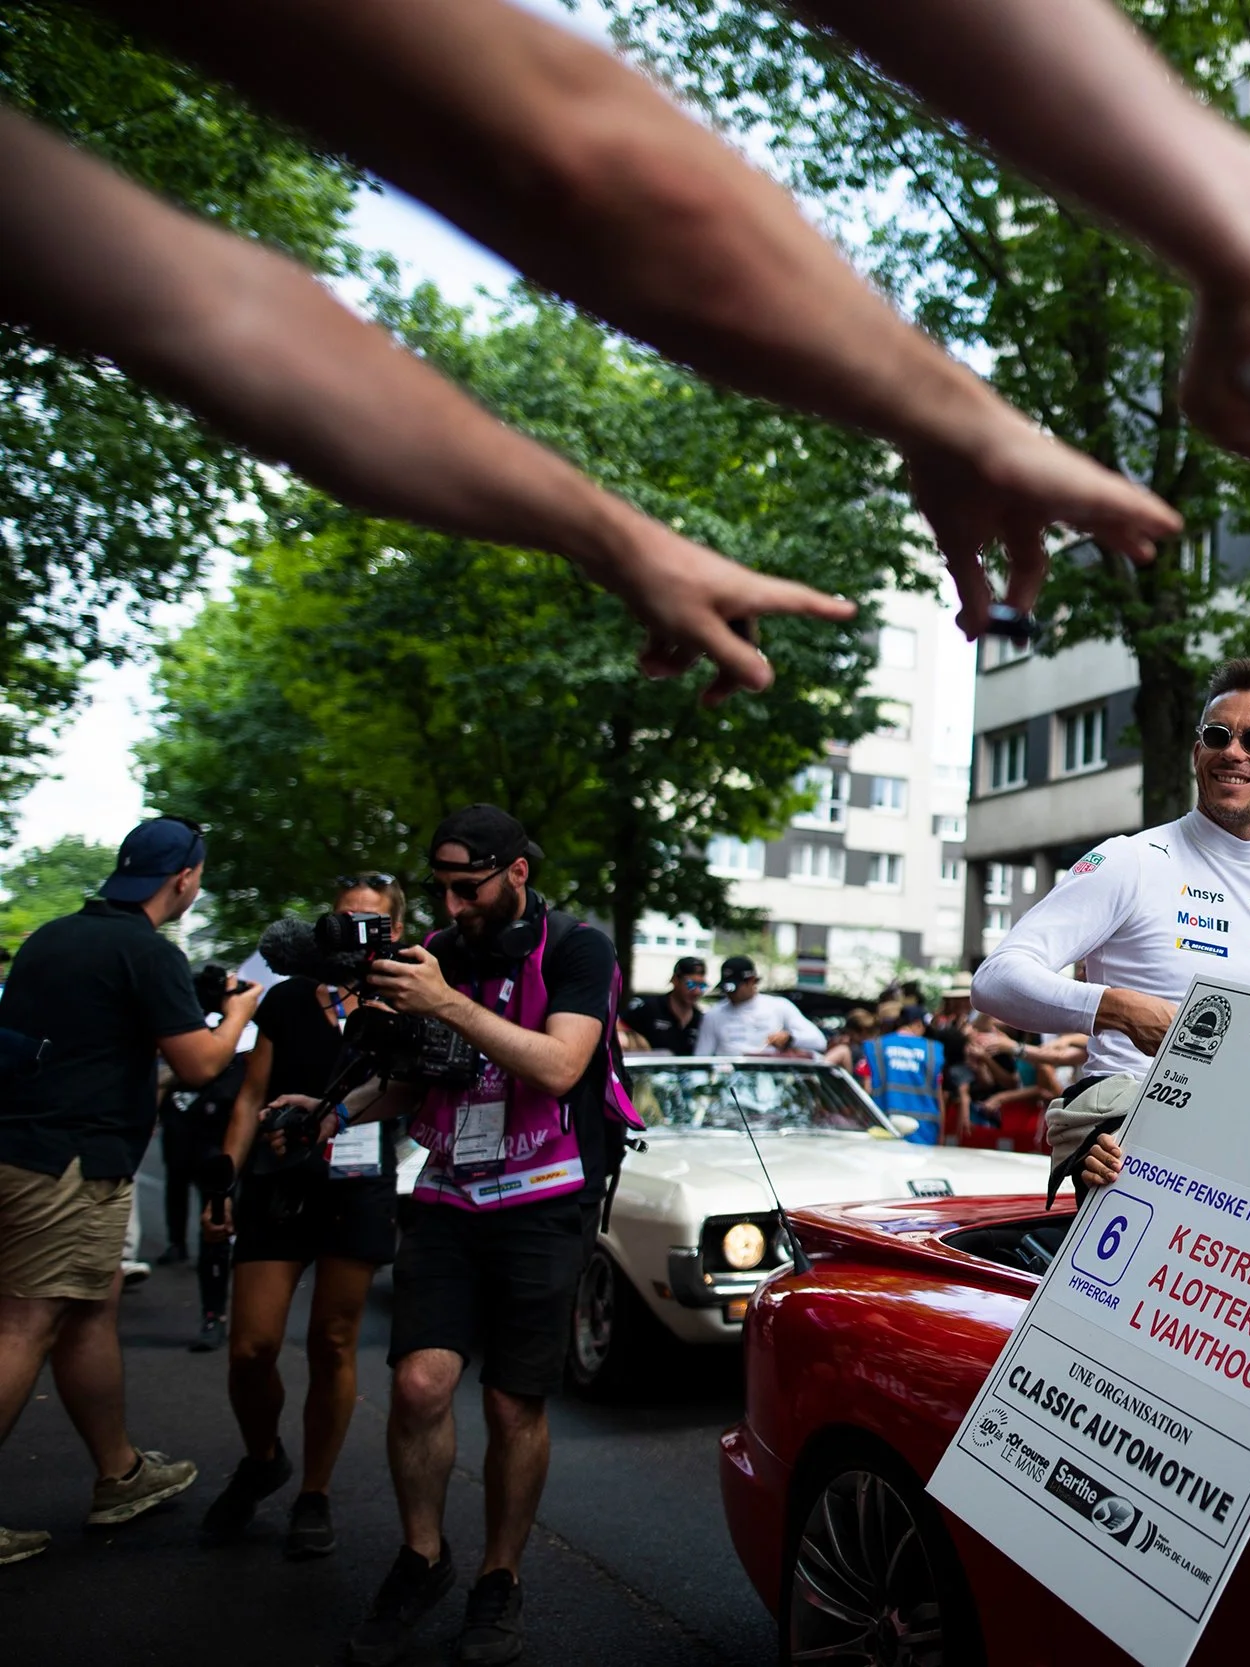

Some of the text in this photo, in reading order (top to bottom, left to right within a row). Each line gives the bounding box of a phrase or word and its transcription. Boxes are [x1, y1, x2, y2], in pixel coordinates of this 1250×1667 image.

[1181, 884, 1225, 903] Ansys
[1177, 910, 1229, 933] Mobil 1
[1191, 943, 1225, 955] MICHELIN
[1163, 1069, 1189, 1086] 9 Juin
[1145, 1082, 1193, 1109] 2023
[1120, 1155, 1188, 1194] PORSCHE
[1185, 1180, 1248, 1218] PENSKE
[1096, 1215, 1128, 1261] 6
[1168, 1224, 1192, 1255] K
[1068, 1275, 1121, 1311] HYPERCAR
[1147, 1264, 1169, 1293] A
[1129, 1300, 1144, 1331] L
[1068, 1362, 1194, 1446] UNE ORGANISATION
[979, 1418, 998, 1435] 100
[1008, 1365, 1236, 1524] CLASSIC AUTOMOTIVE
[1020, 1444, 1051, 1470] course
[1000, 1443, 1046, 1484] LE MANS
[1055, 1464, 1099, 1505] Sarthe
[1153, 1539, 1213, 1586] PAYS DE LA LOIRE
